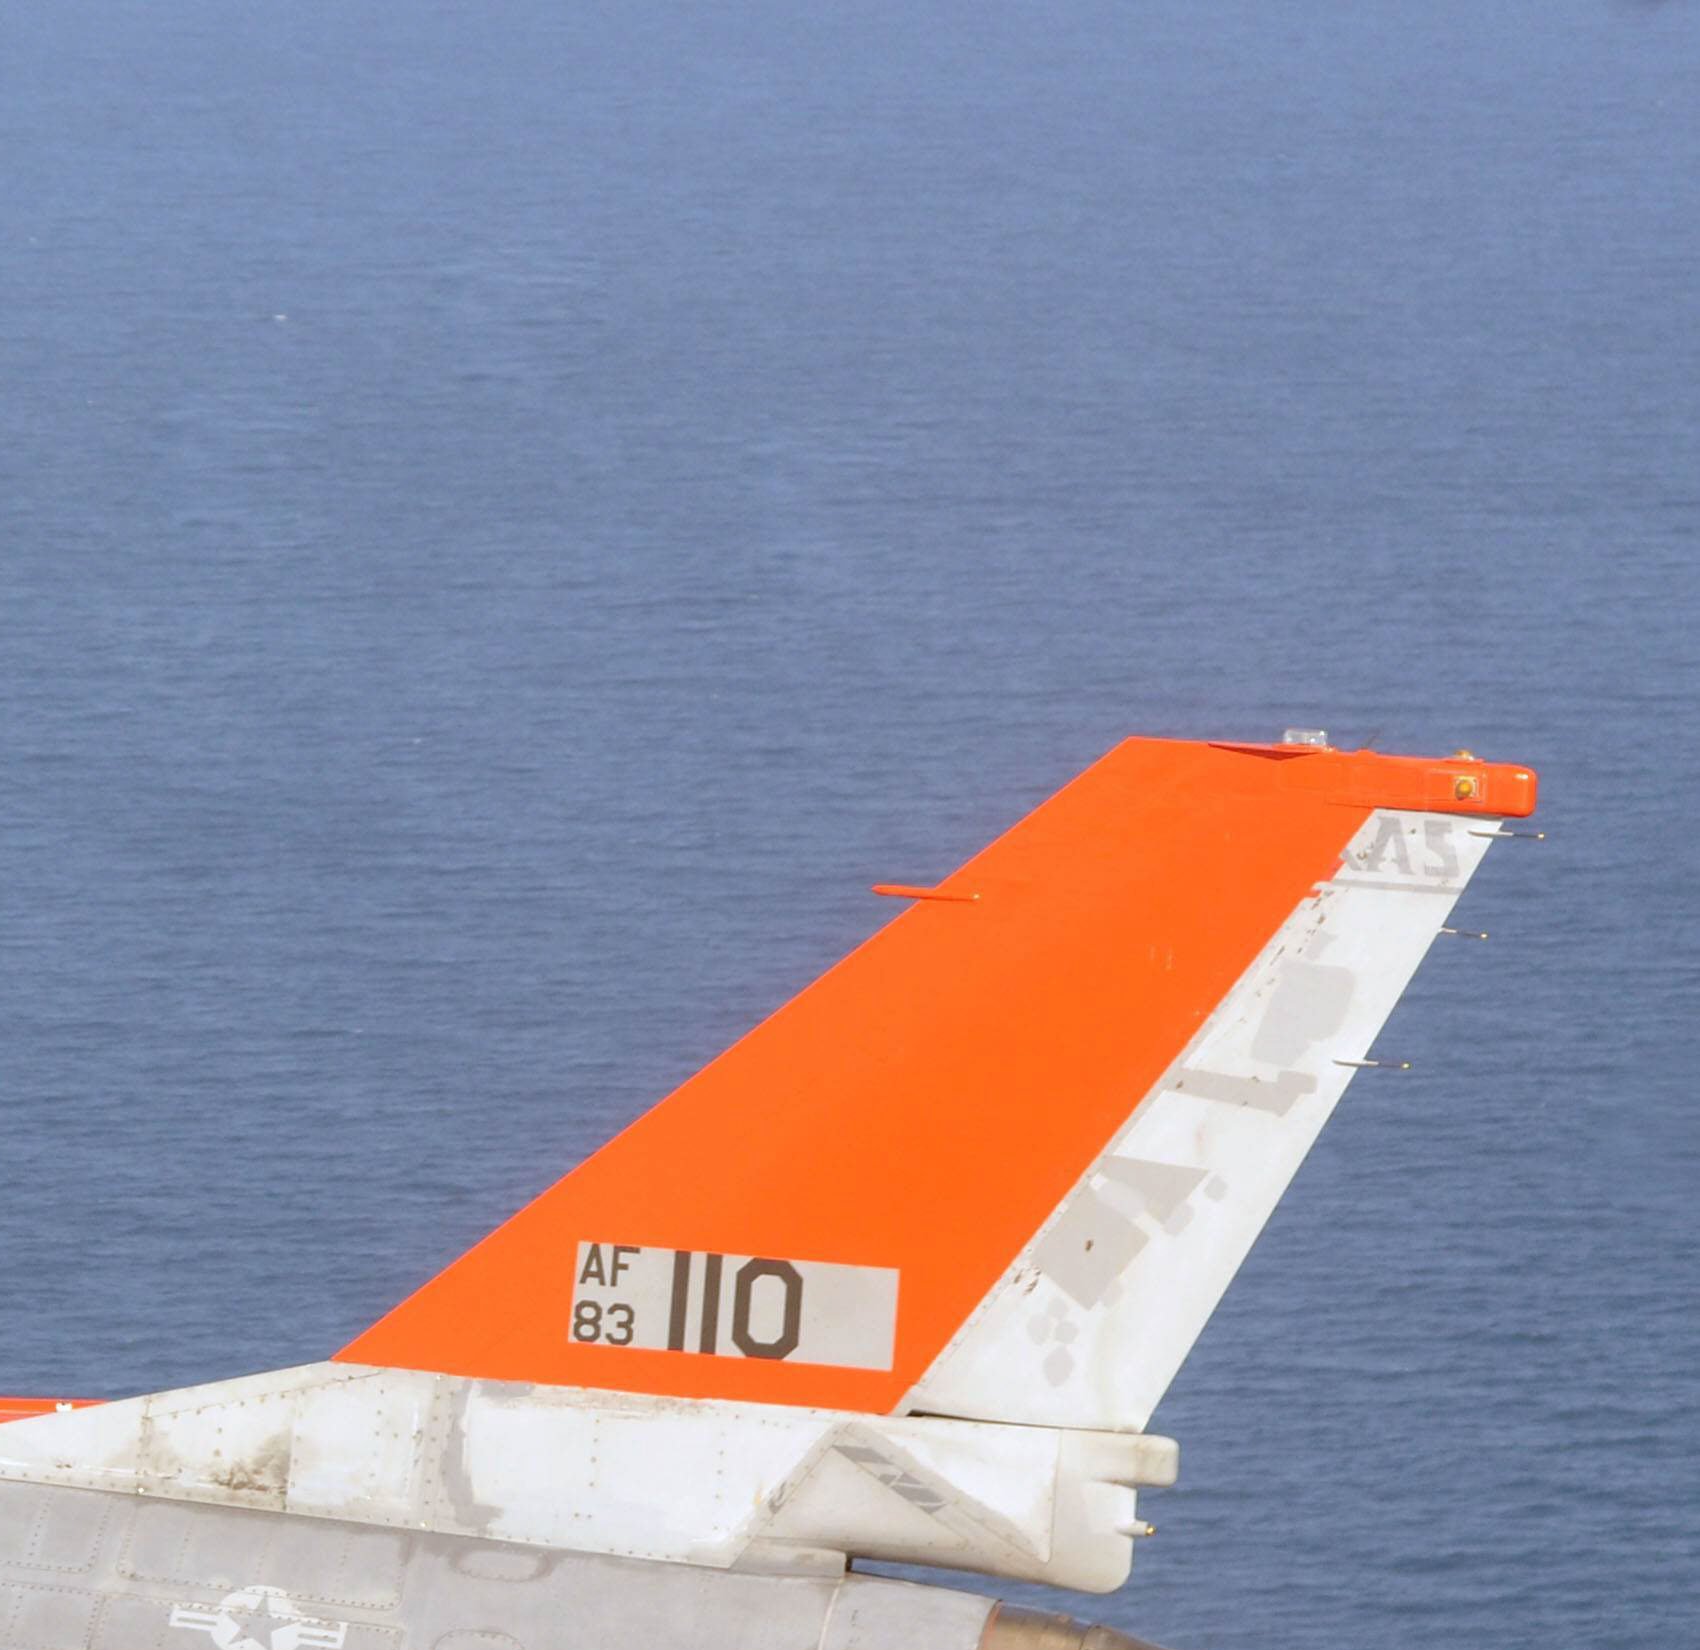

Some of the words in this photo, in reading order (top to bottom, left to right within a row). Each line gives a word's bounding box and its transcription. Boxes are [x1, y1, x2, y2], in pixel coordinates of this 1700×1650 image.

[579, 1243, 641, 1287] AF
[573, 1299, 635, 1346] 83
[667, 1250, 804, 1361] 110
